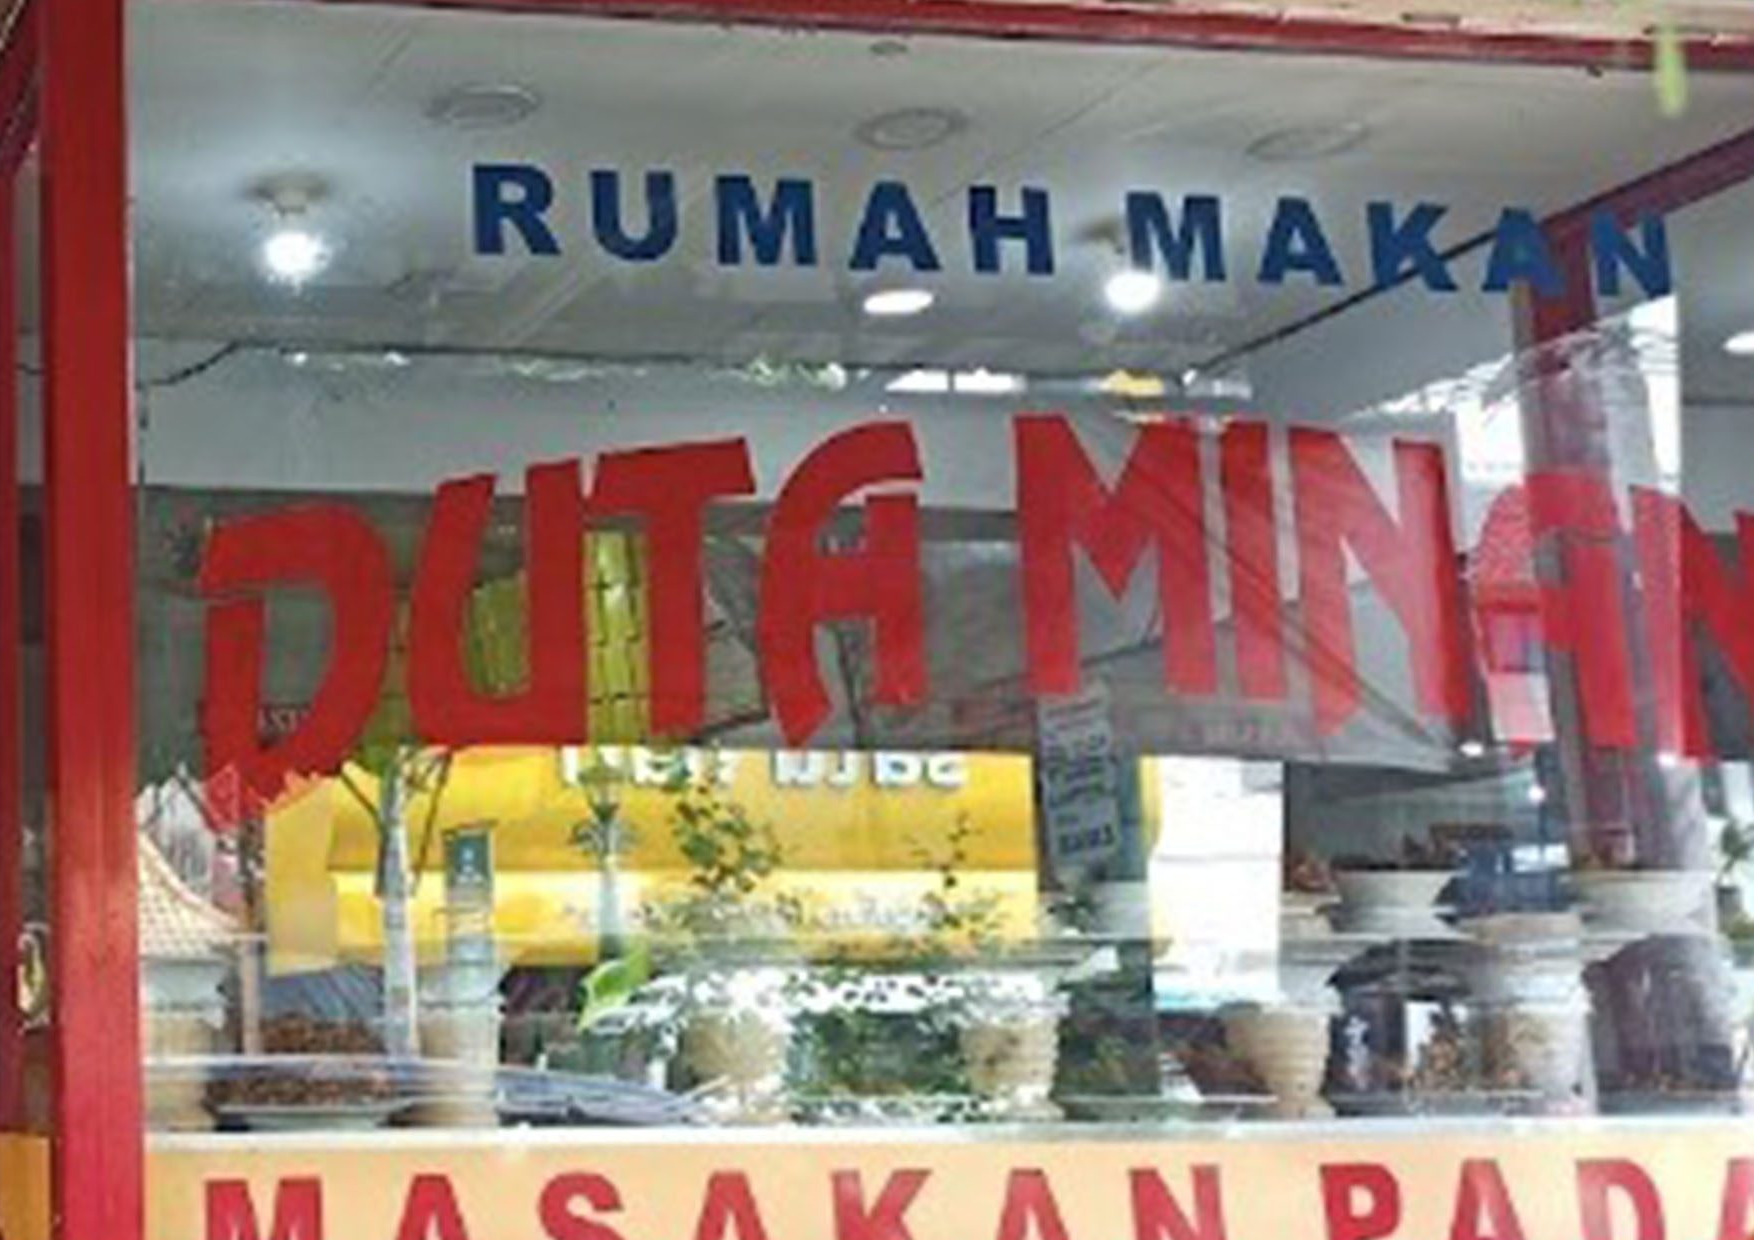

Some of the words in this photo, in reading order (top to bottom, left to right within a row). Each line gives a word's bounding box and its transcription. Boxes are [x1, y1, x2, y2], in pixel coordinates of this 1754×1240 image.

[469, 162, 1055, 279] RUMAH
[1126, 190, 1676, 299] MAKAN
[197, 420, 925, 834] DUTA
